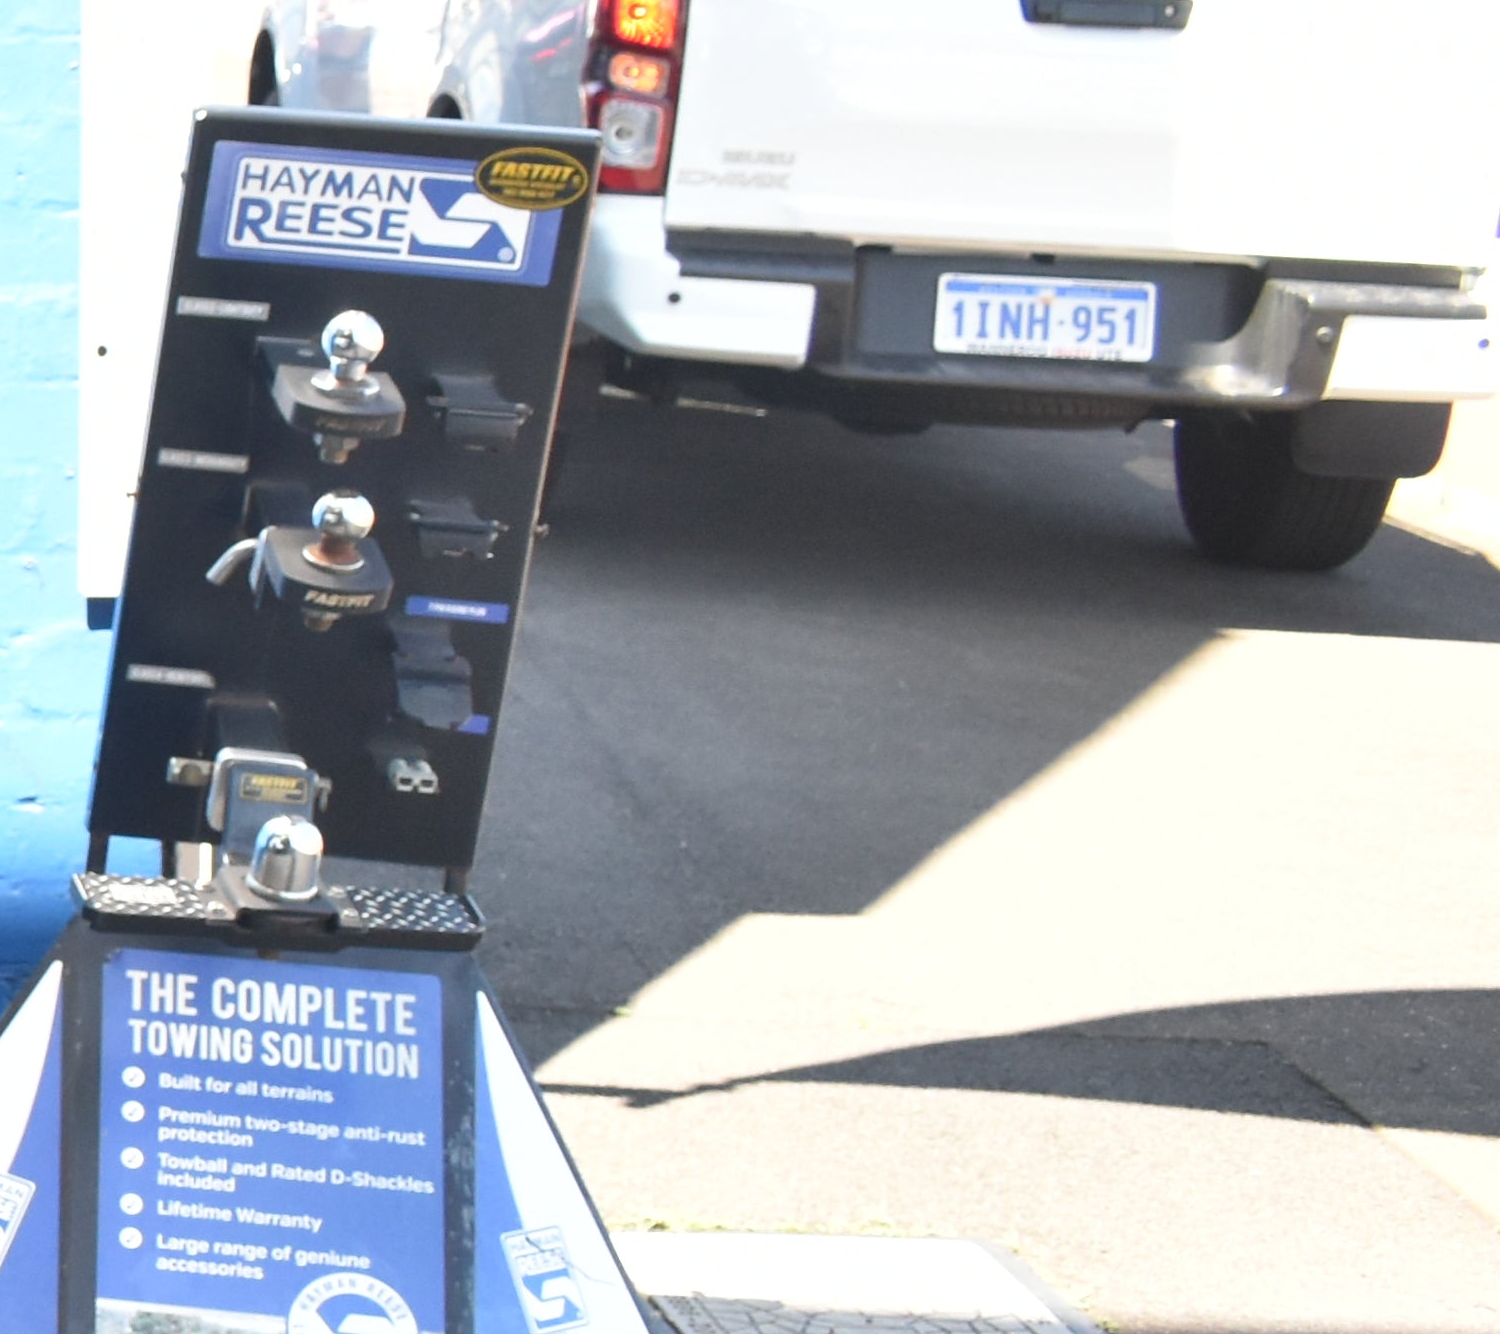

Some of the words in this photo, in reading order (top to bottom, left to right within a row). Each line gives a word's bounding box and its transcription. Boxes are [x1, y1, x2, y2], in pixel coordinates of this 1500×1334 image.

[241, 163, 416, 204] HAYMAN
[491, 161, 576, 181] FASTFIT
[233, 197, 409, 244] REESE
[304, 589, 375, 609] FASTFIT
[126, 970, 198, 1016] THE
[212, 977, 417, 1036] COMPLETE
[127, 1019, 253, 1064] TOWING
[261, 1031, 419, 1079] SOLUTION
[158, 1073, 202, 1091] Built
[205, 1076, 232, 1094] for
[235, 1079, 258, 1097] all
[261, 1082, 334, 1103] terrains
[157, 1125, 254, 1148] protection
[158, 1106, 241, 1128] Premium
[245, 1114, 340, 1141] two-stage
[343, 1126, 427, 1147] anti-rust
[156, 1170, 236, 1193] included
[157, 1152, 228, 1174] Towball
[231, 1162, 267, 1178] and
[271, 1163, 327, 1184] Rated
[330, 1167, 435, 1195] D-Shackles
[156, 1199, 232, 1222] Lifetime
[236, 1207, 323, 1234] Warranty
[156, 1233, 210, 1256] Large
[213, 1242, 267, 1262] range
[270, 1245, 293, 1262] of
[155, 1255, 264, 1281] accessories
